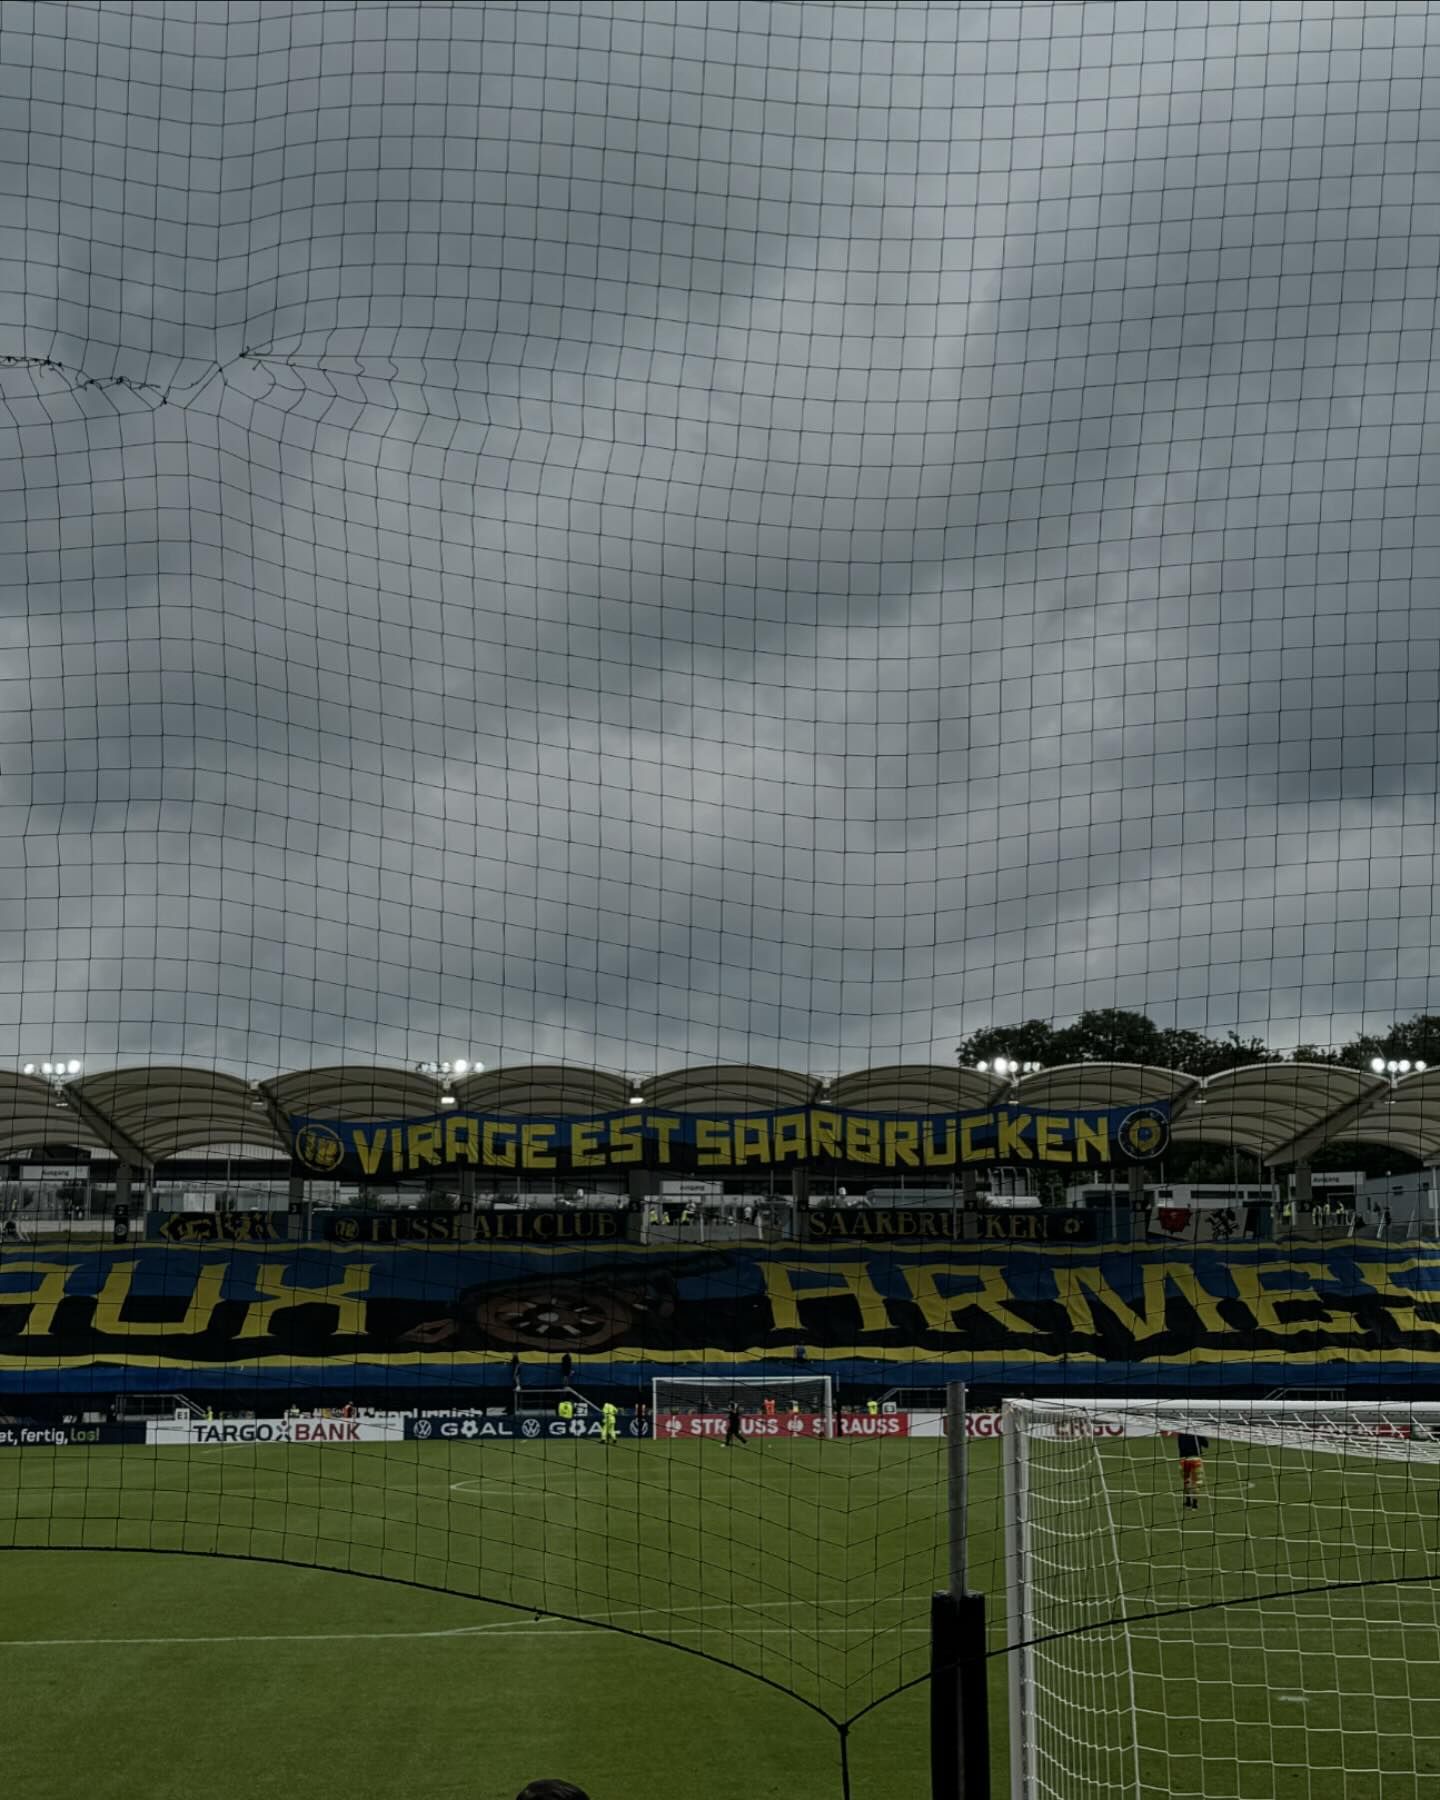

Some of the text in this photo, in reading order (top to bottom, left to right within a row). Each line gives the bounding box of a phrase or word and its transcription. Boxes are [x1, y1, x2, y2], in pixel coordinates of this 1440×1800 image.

[352, 1116, 556, 1174] VIRAGE
[571, 1113, 680, 1167] EST
[696, 1109, 1110, 1167] SAARBRÜCKEN
[440, 1420, 513, 1438] GOAL
[691, 1417, 779, 1435] STRUSS
[21, 1427, 68, 1446] fertig,
